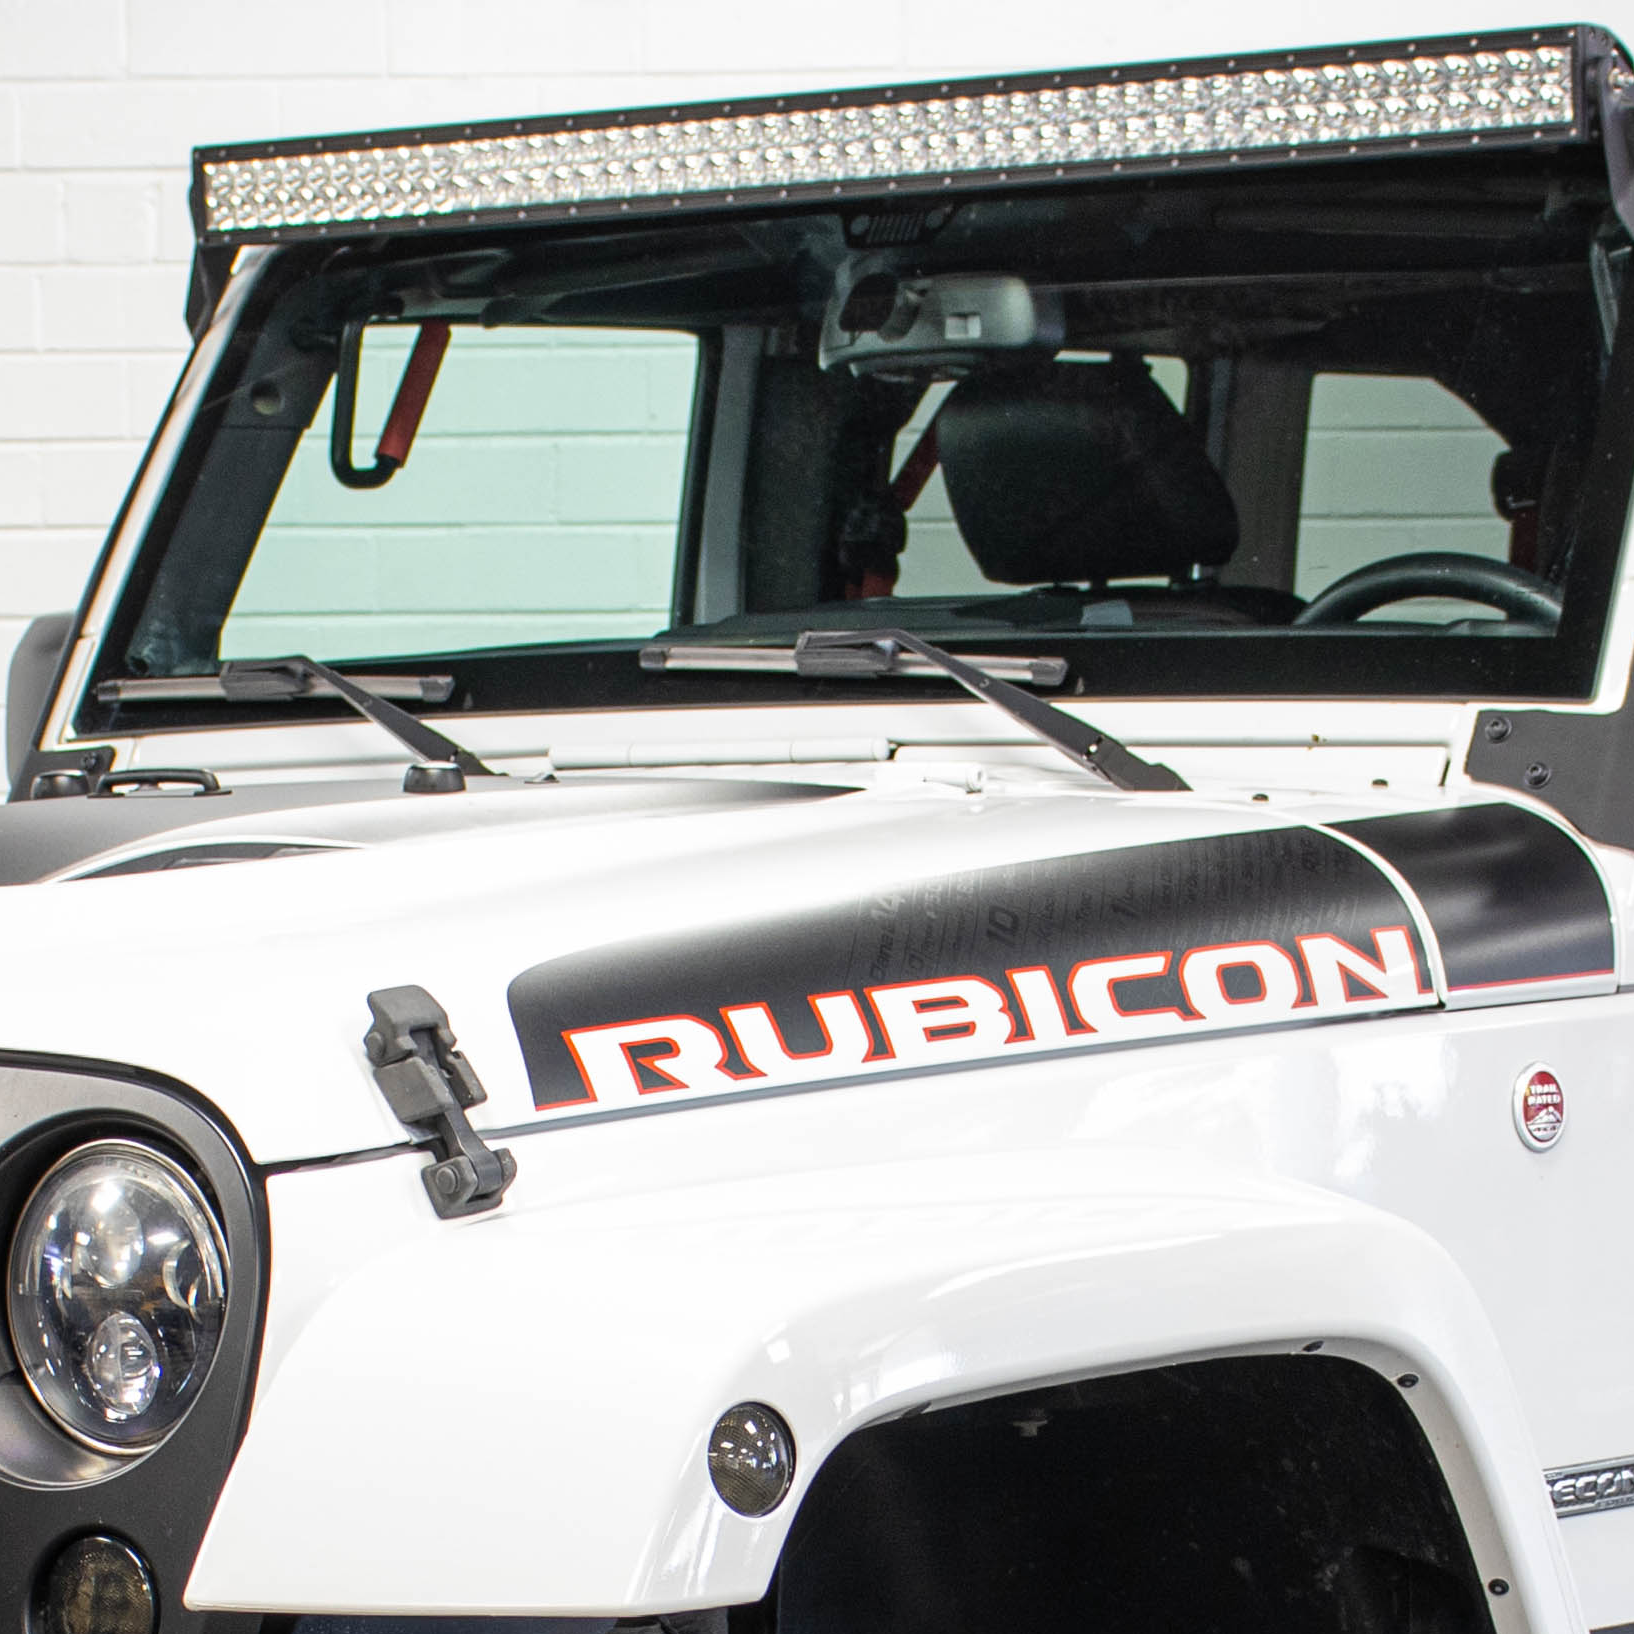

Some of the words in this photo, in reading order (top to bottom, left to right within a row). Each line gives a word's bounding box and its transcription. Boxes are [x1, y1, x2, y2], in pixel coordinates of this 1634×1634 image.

[534, 925, 1433, 1110] RUBICON
[1529, 1084, 1558, 1095] TRAIL
[1526, 1094, 1561, 1106] RATED
